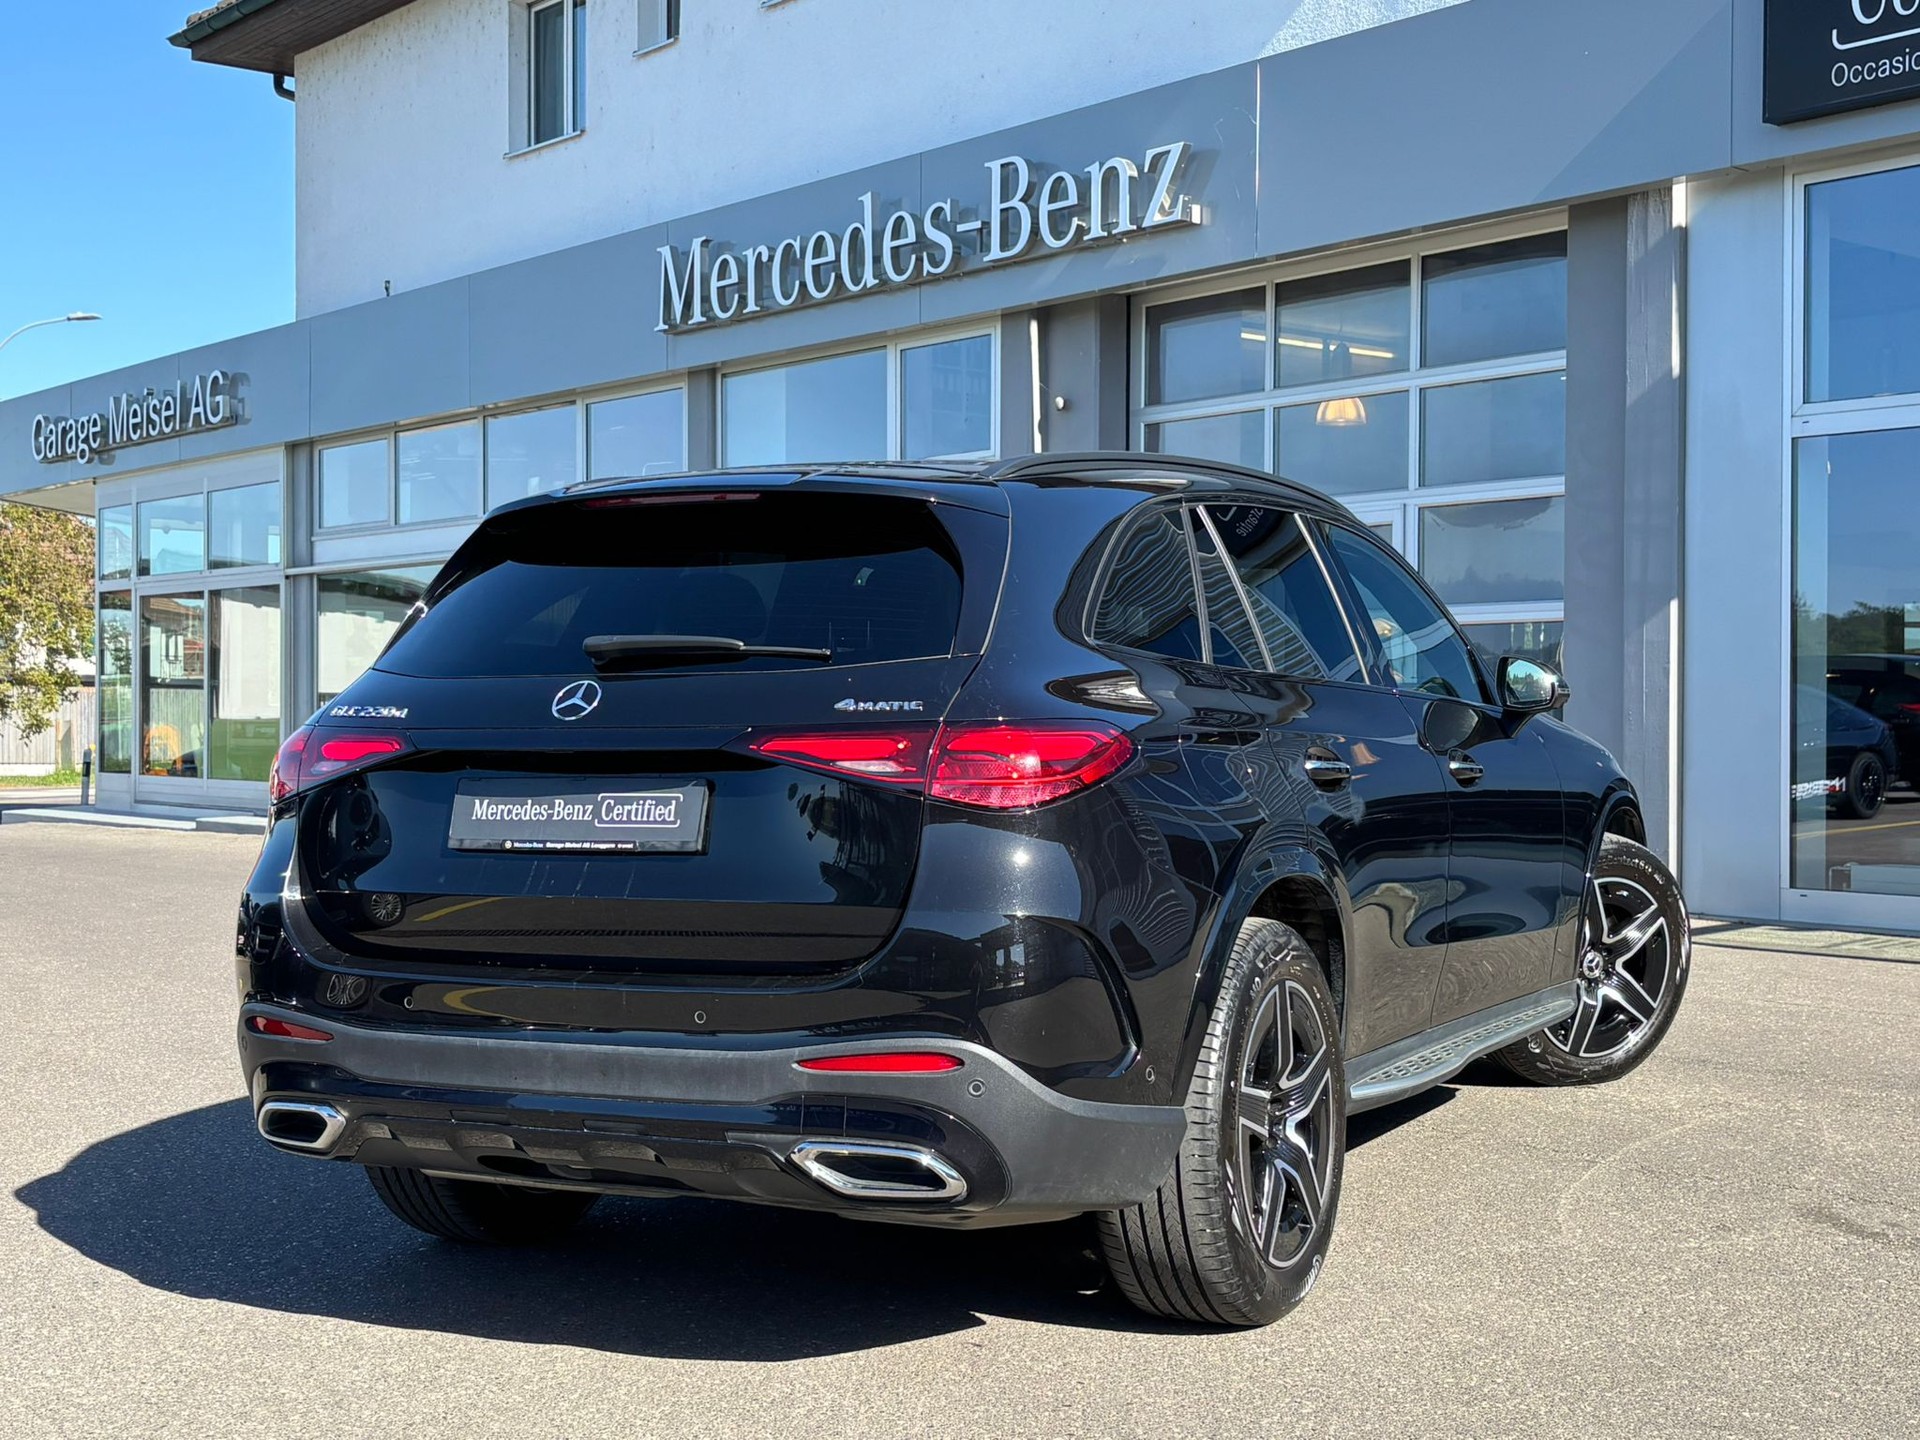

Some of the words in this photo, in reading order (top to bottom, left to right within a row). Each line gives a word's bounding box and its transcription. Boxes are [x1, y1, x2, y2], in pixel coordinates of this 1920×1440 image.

[653, 141, 1190, 332] Mercedes-Benz
[31, 413, 101, 464] Garage
[109, 379, 180, 445] Meisel
[189, 369, 224, 427] AG
[833, 698, 924, 711] 4MATIC
[472, 798, 593, 821] Mercedes-Benz
[601, 799, 677, 821] Certified
